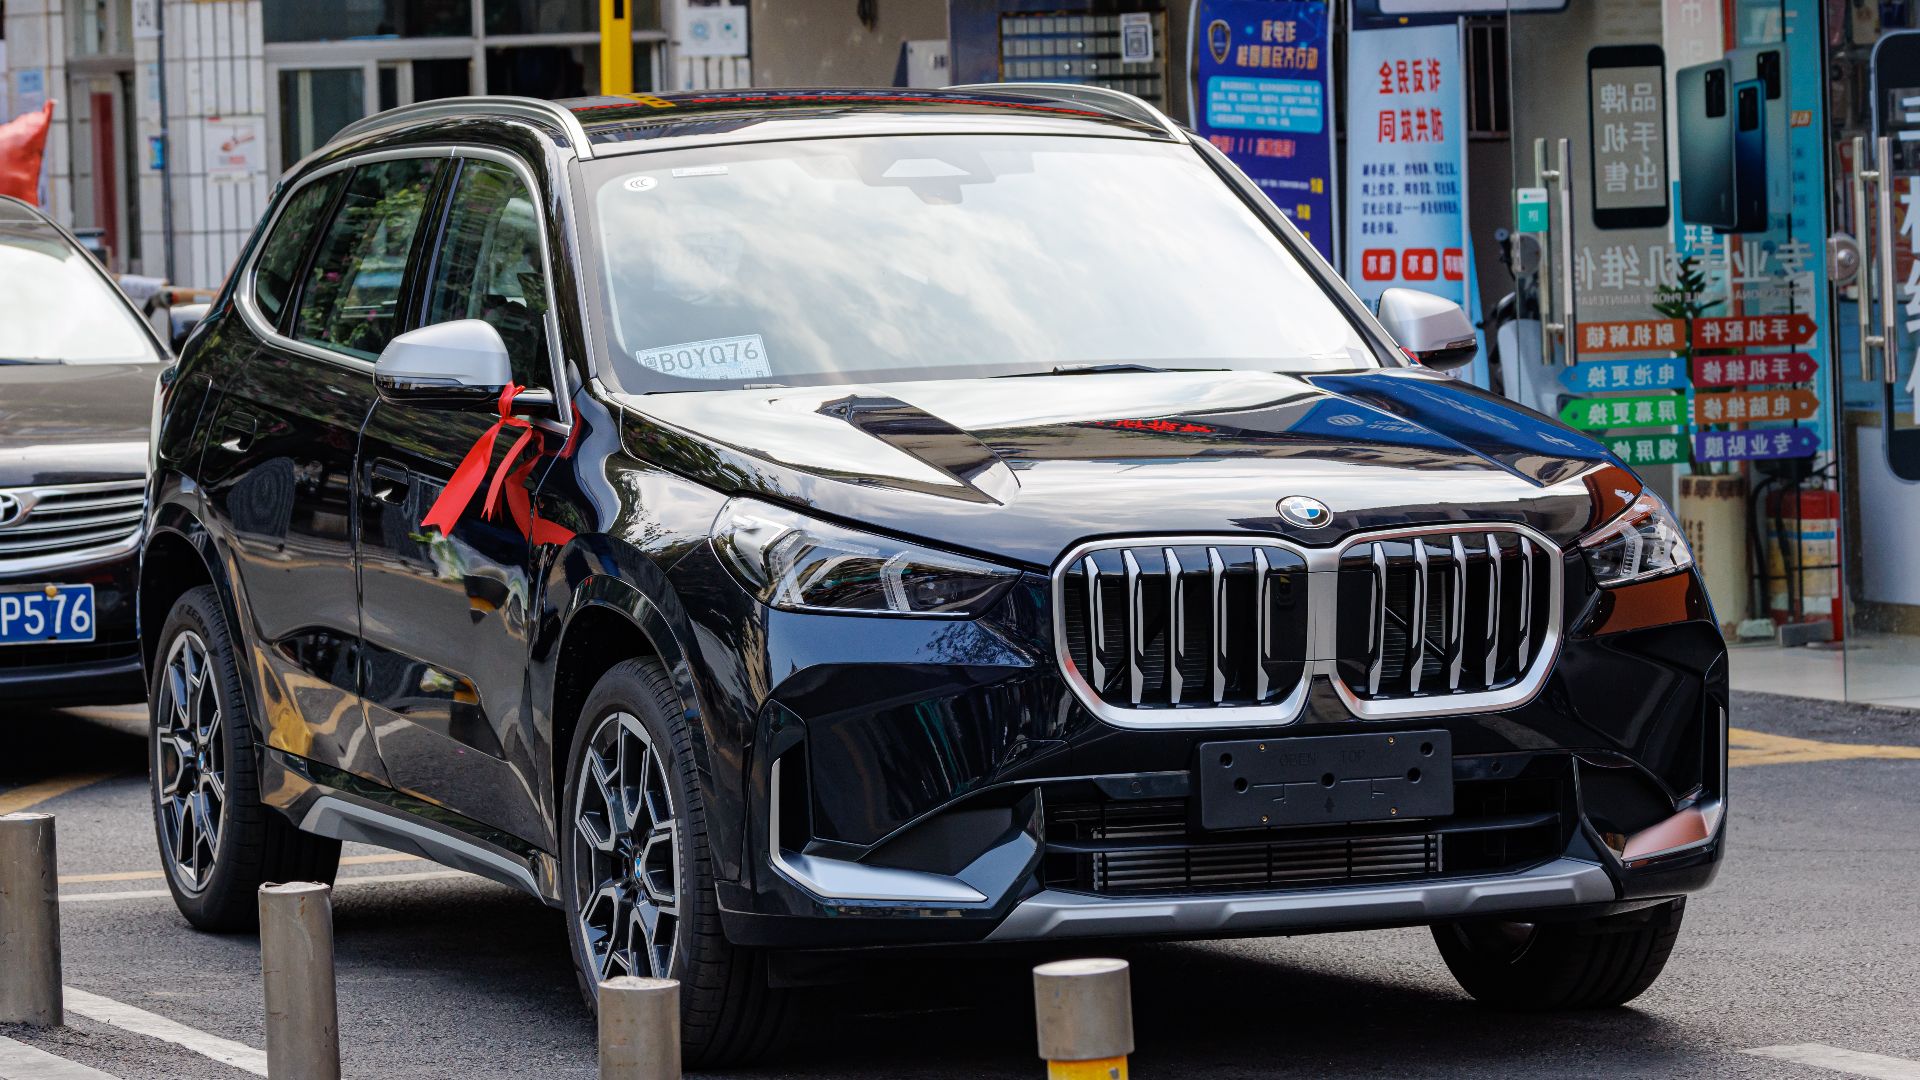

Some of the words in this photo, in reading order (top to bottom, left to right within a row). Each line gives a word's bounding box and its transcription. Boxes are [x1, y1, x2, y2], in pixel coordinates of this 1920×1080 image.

[1379, 58, 1441, 94] 全民反诈
[0, 593, 91, 636] P576
